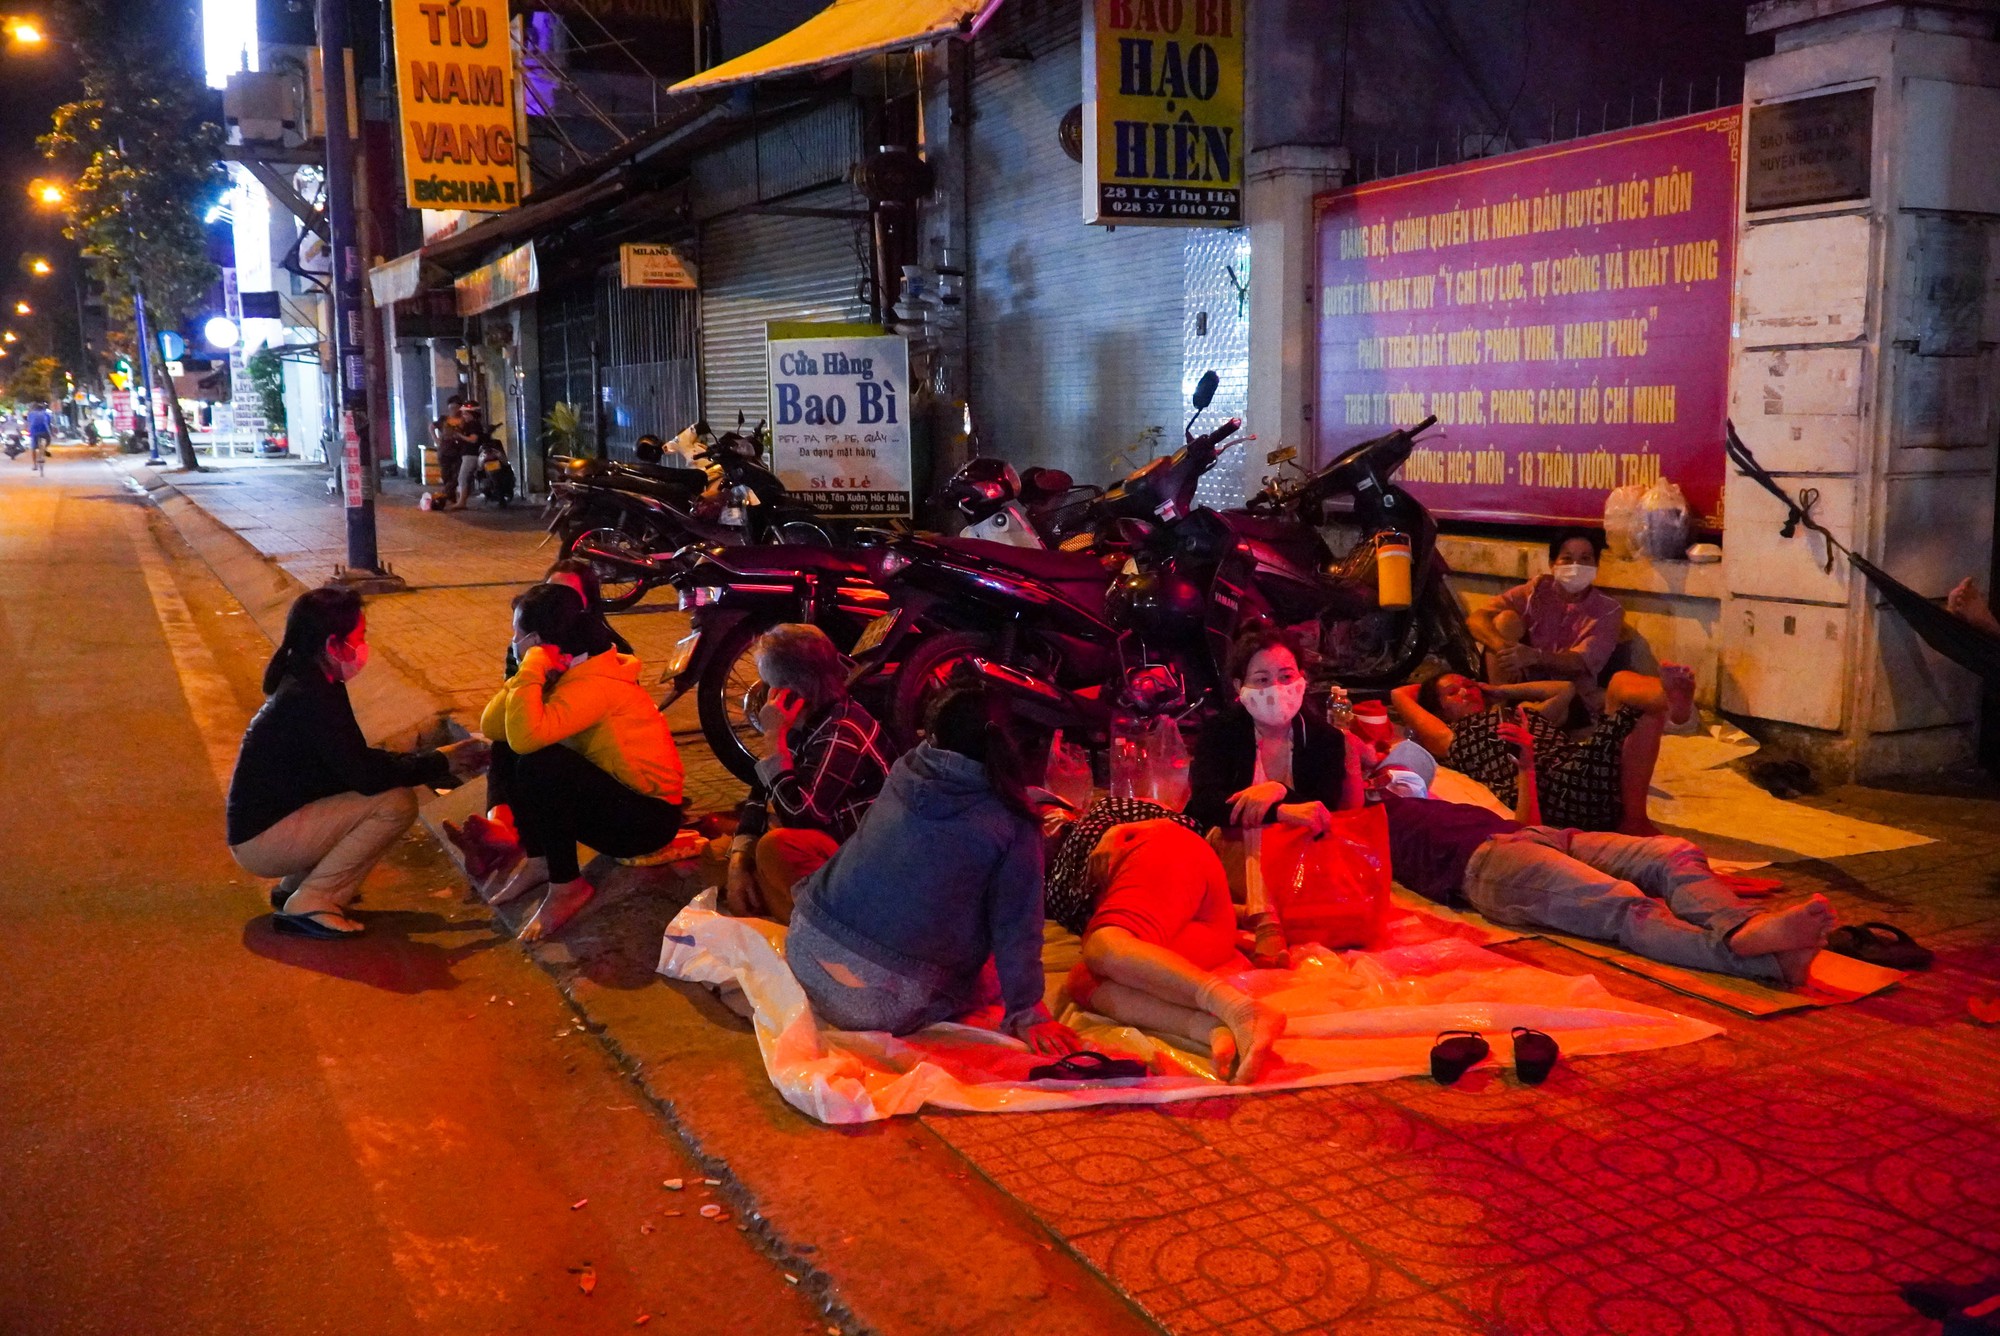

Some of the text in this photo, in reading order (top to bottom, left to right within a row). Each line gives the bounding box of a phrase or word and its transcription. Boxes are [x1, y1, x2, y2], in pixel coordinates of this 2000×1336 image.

[419, 0, 488, 48] TÍU
[1108, 0, 1184, 34] BAO
[410, 60, 504, 107] NAM
[1119, 38, 1219, 112] HẠO
[409, 121, 514, 168] VANG
[1114, 110, 1233, 183] HIÊN
[414, 174, 468, 203] BÍCH
[470, 175, 500, 203] HÀ
[1104, 187, 1236, 203] 28 Lê Thị Hà
[1112, 201, 1230, 215] 028 37 1010 79
[1392, 212, 1427, 254] CHÍNH
[1430, 199, 1469, 252] QUYỀN
[1473, 199, 1489, 242] VÀ
[1493, 193, 1529, 239] NHÂN
[1533, 188, 1561, 233] DÂN
[1566, 179, 1613, 233] HUYỆN
[1618, 173, 1649, 221] HÓC
[1653, 165, 1692, 216] MÔN
[1382, 271, 1410, 312] PHÁT
[1413, 274, 1436, 309] HUY
[1456, 262, 1477, 305] CHÍ
[1480, 264, 1498, 309] TỰ
[1531, 258, 1549, 305] TỰ
[1552, 248, 1600, 296] CƯỜNG
[1605, 244, 1624, 290] VÀ
[1628, 239, 1669, 288] KHÁT
[1674, 239, 1719, 292] VỌNG
[780, 350, 874, 380] Cửa Hàng
[1388, 321, 1420, 368] TRIỂN
[1422, 321, 1445, 367] ĐẤT
[1448, 322, 1481, 365] NƯỚC
[1485, 316, 1520, 363] PHỒN
[1563, 321, 1602, 368] HẠNH
[775, 380, 898, 425] Bao Bì
[1344, 394, 1371, 425] THEO
[1491, 388, 1535, 424] PHONG
[1538, 382, 1576, 425] CÁCH
[1580, 375, 1600, 425] HỒ
[1603, 378, 1629, 425] CHÍ
[1633, 385, 1676, 424] MINH
[799, 447, 810, 457] Đa
[813, 447, 833, 458] dạng
[855, 447, 876, 458] hàng
[1448, 444, 1472, 484] HÓC
[1475, 443, 1505, 485] MÔN
[1518, 451, 1533, 486] 18
[1537, 445, 1574, 488] THÔN
[1578, 444, 1616, 489] VƯỜN
[811, 475, 871, 489] Sỉ & Lẻ
